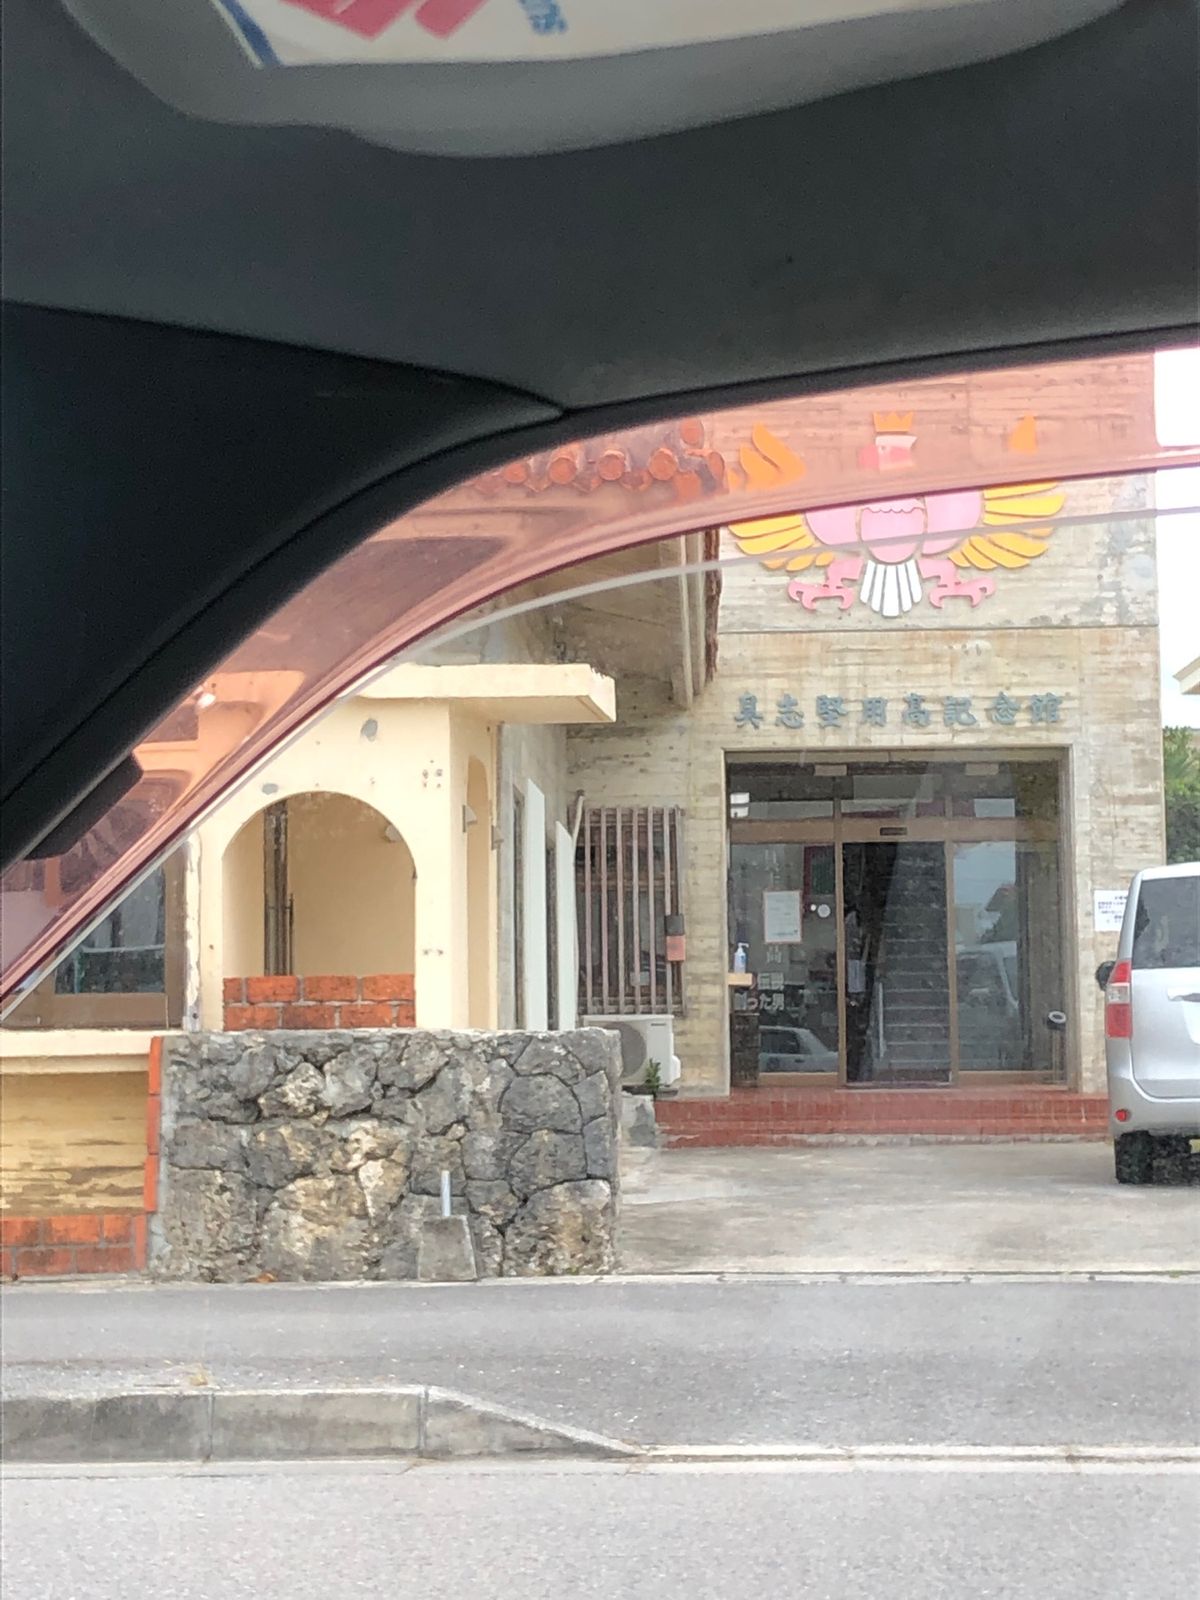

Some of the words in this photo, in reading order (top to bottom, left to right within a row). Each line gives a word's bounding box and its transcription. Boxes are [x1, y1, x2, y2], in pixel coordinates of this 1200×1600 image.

[734, 691, 1063, 729] 具志堅用高記念館
